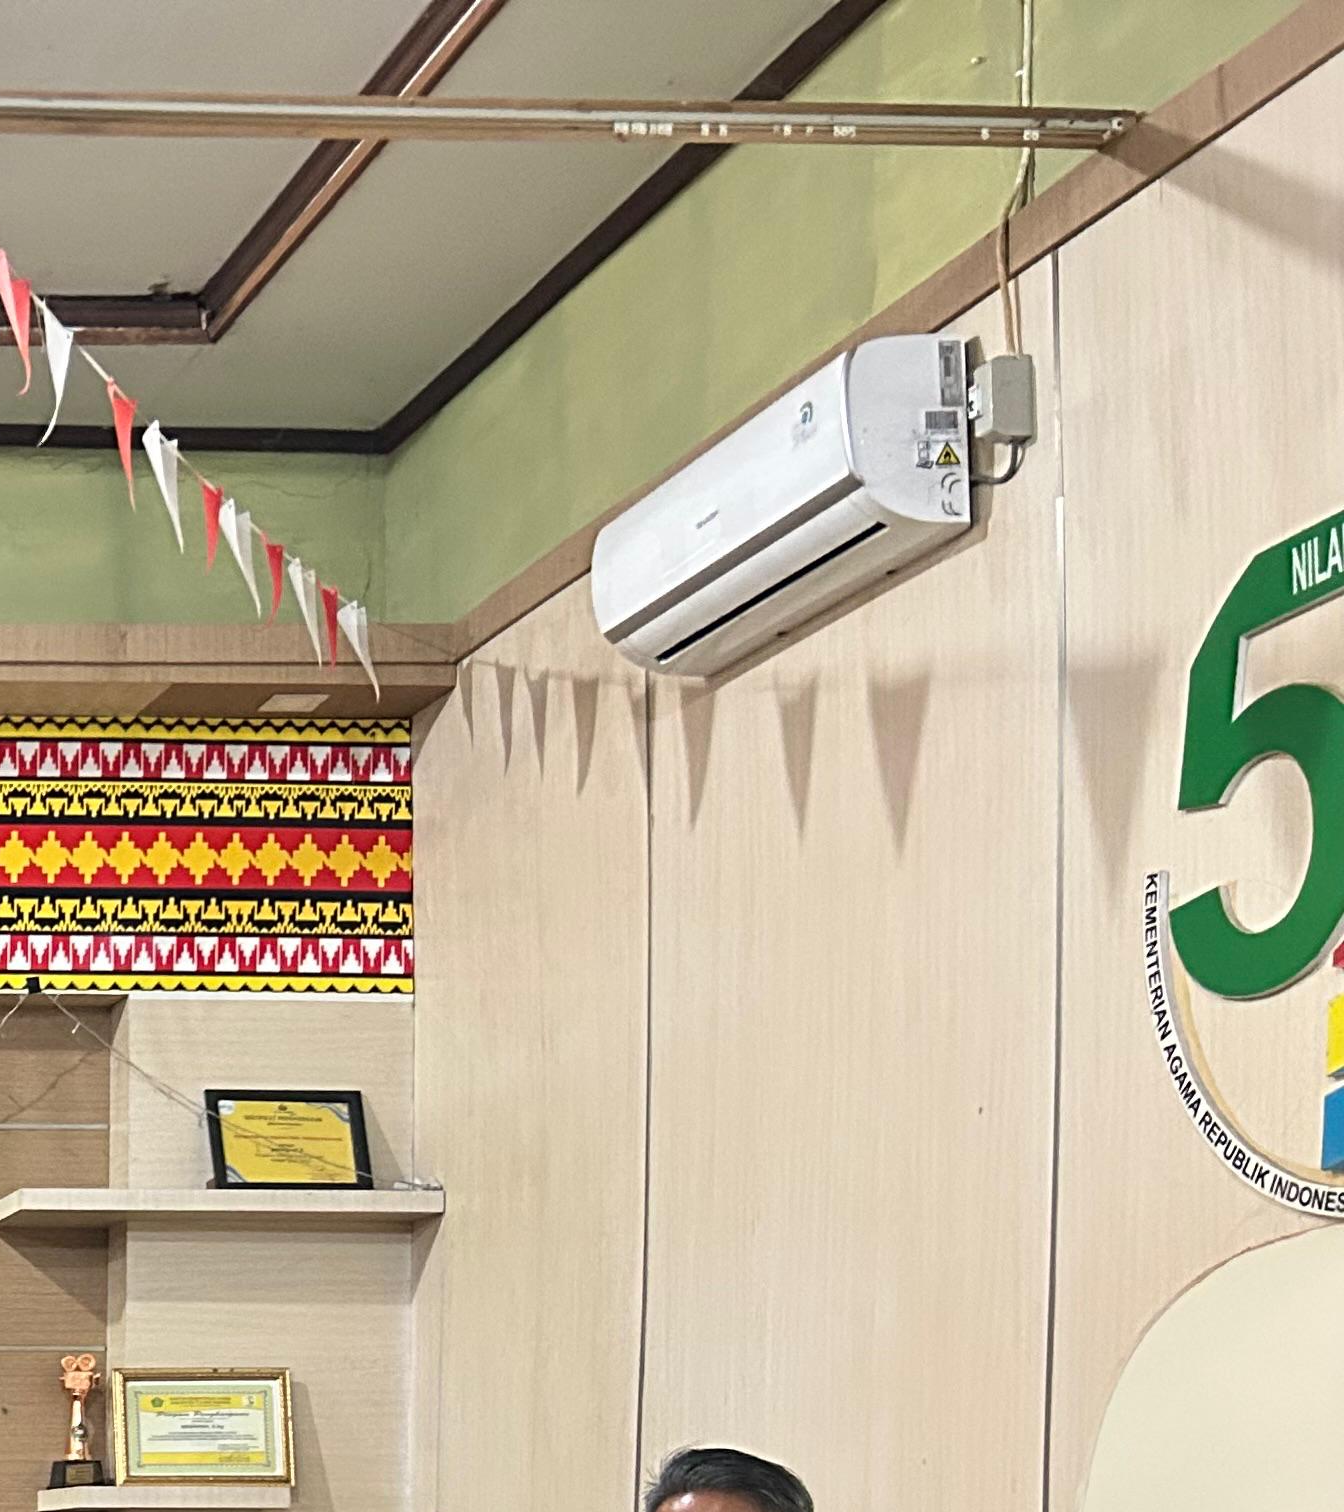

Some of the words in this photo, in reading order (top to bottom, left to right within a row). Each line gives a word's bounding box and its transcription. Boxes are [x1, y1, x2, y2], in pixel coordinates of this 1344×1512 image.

[1291, 523, 1344, 596] NILA
[1144, 872, 1172, 1041] KEMENTERIAN
[1163, 1043, 1201, 1118] AGAMA
[1198, 1110, 1270, 1190] REPUBLIK
